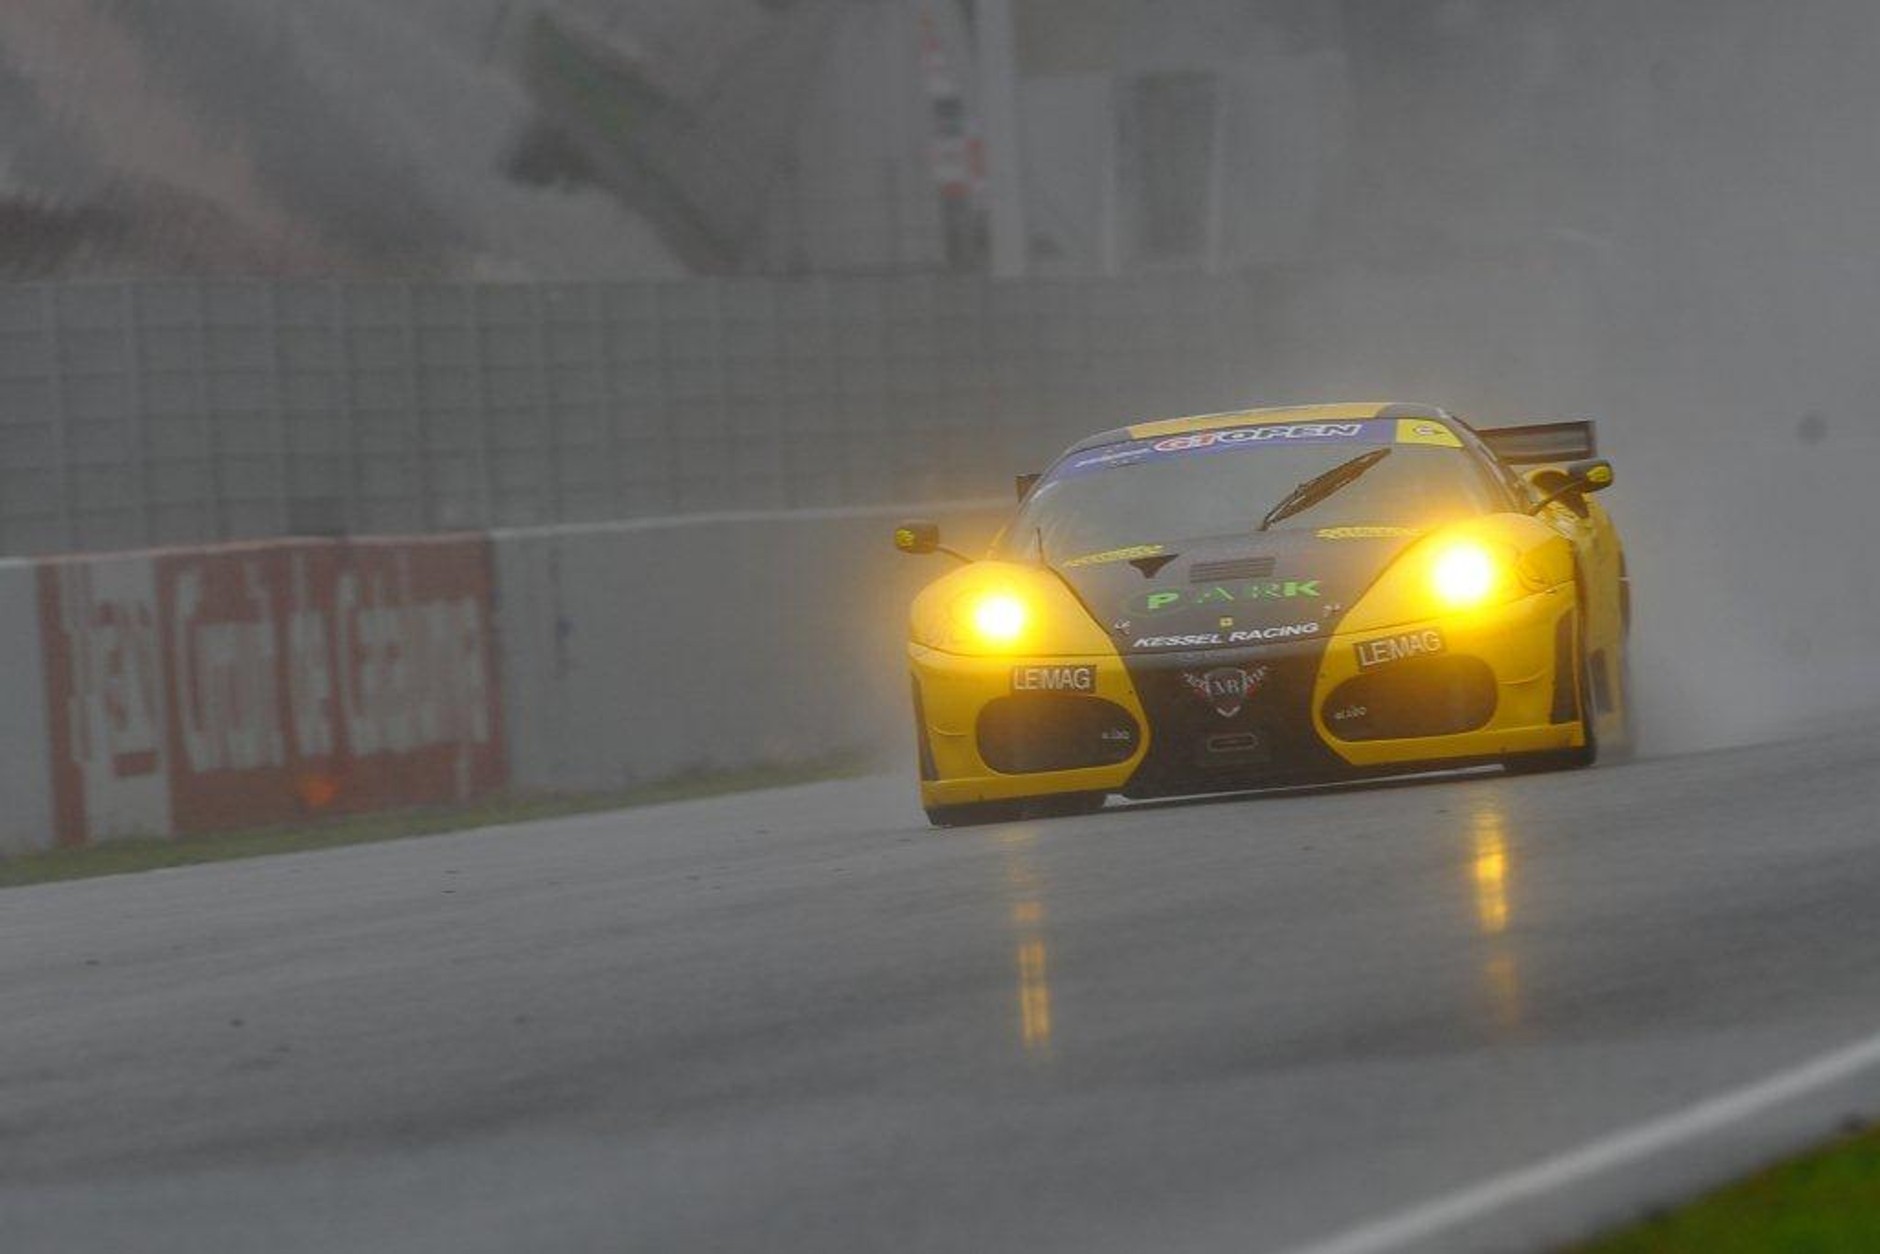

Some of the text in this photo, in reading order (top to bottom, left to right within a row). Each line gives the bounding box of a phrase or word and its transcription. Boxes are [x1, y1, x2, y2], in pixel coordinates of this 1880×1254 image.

[1146, 580, 1321, 610] PARK
[1132, 622, 1319, 648] KESSEL RACING
[1358, 629, 1441, 667] LEMAG
[1013, 666, 1091, 690] LEMAG
